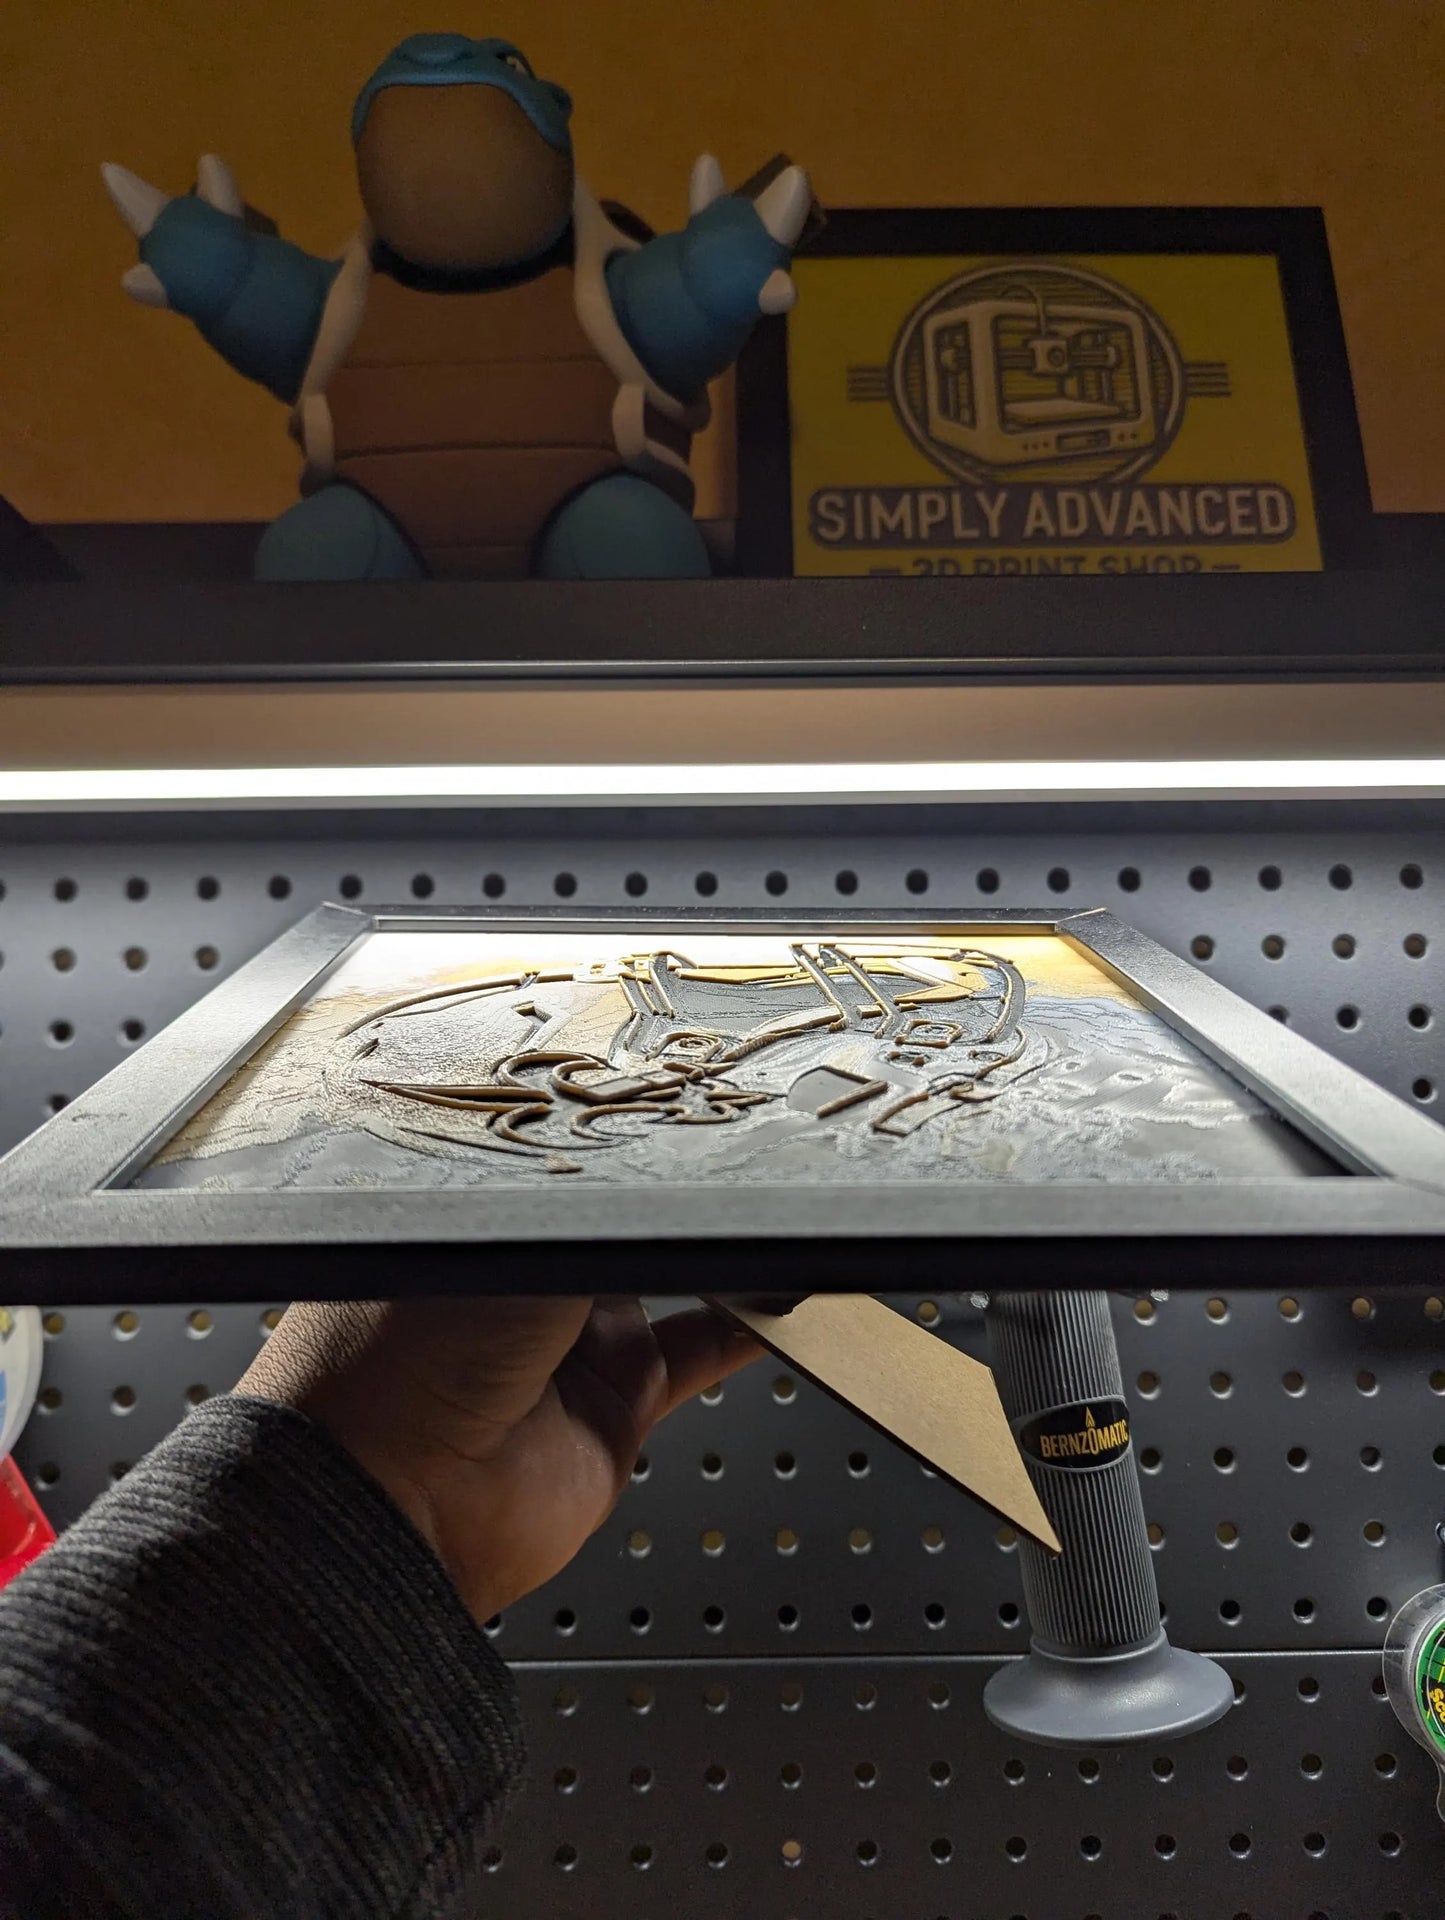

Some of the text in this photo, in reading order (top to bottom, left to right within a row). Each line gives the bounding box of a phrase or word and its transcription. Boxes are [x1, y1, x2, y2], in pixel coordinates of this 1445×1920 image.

[816, 488, 1289, 541] SIMPLY ADVANCED
[1040, 1419, 1129, 1457] BERNZOMATIC
